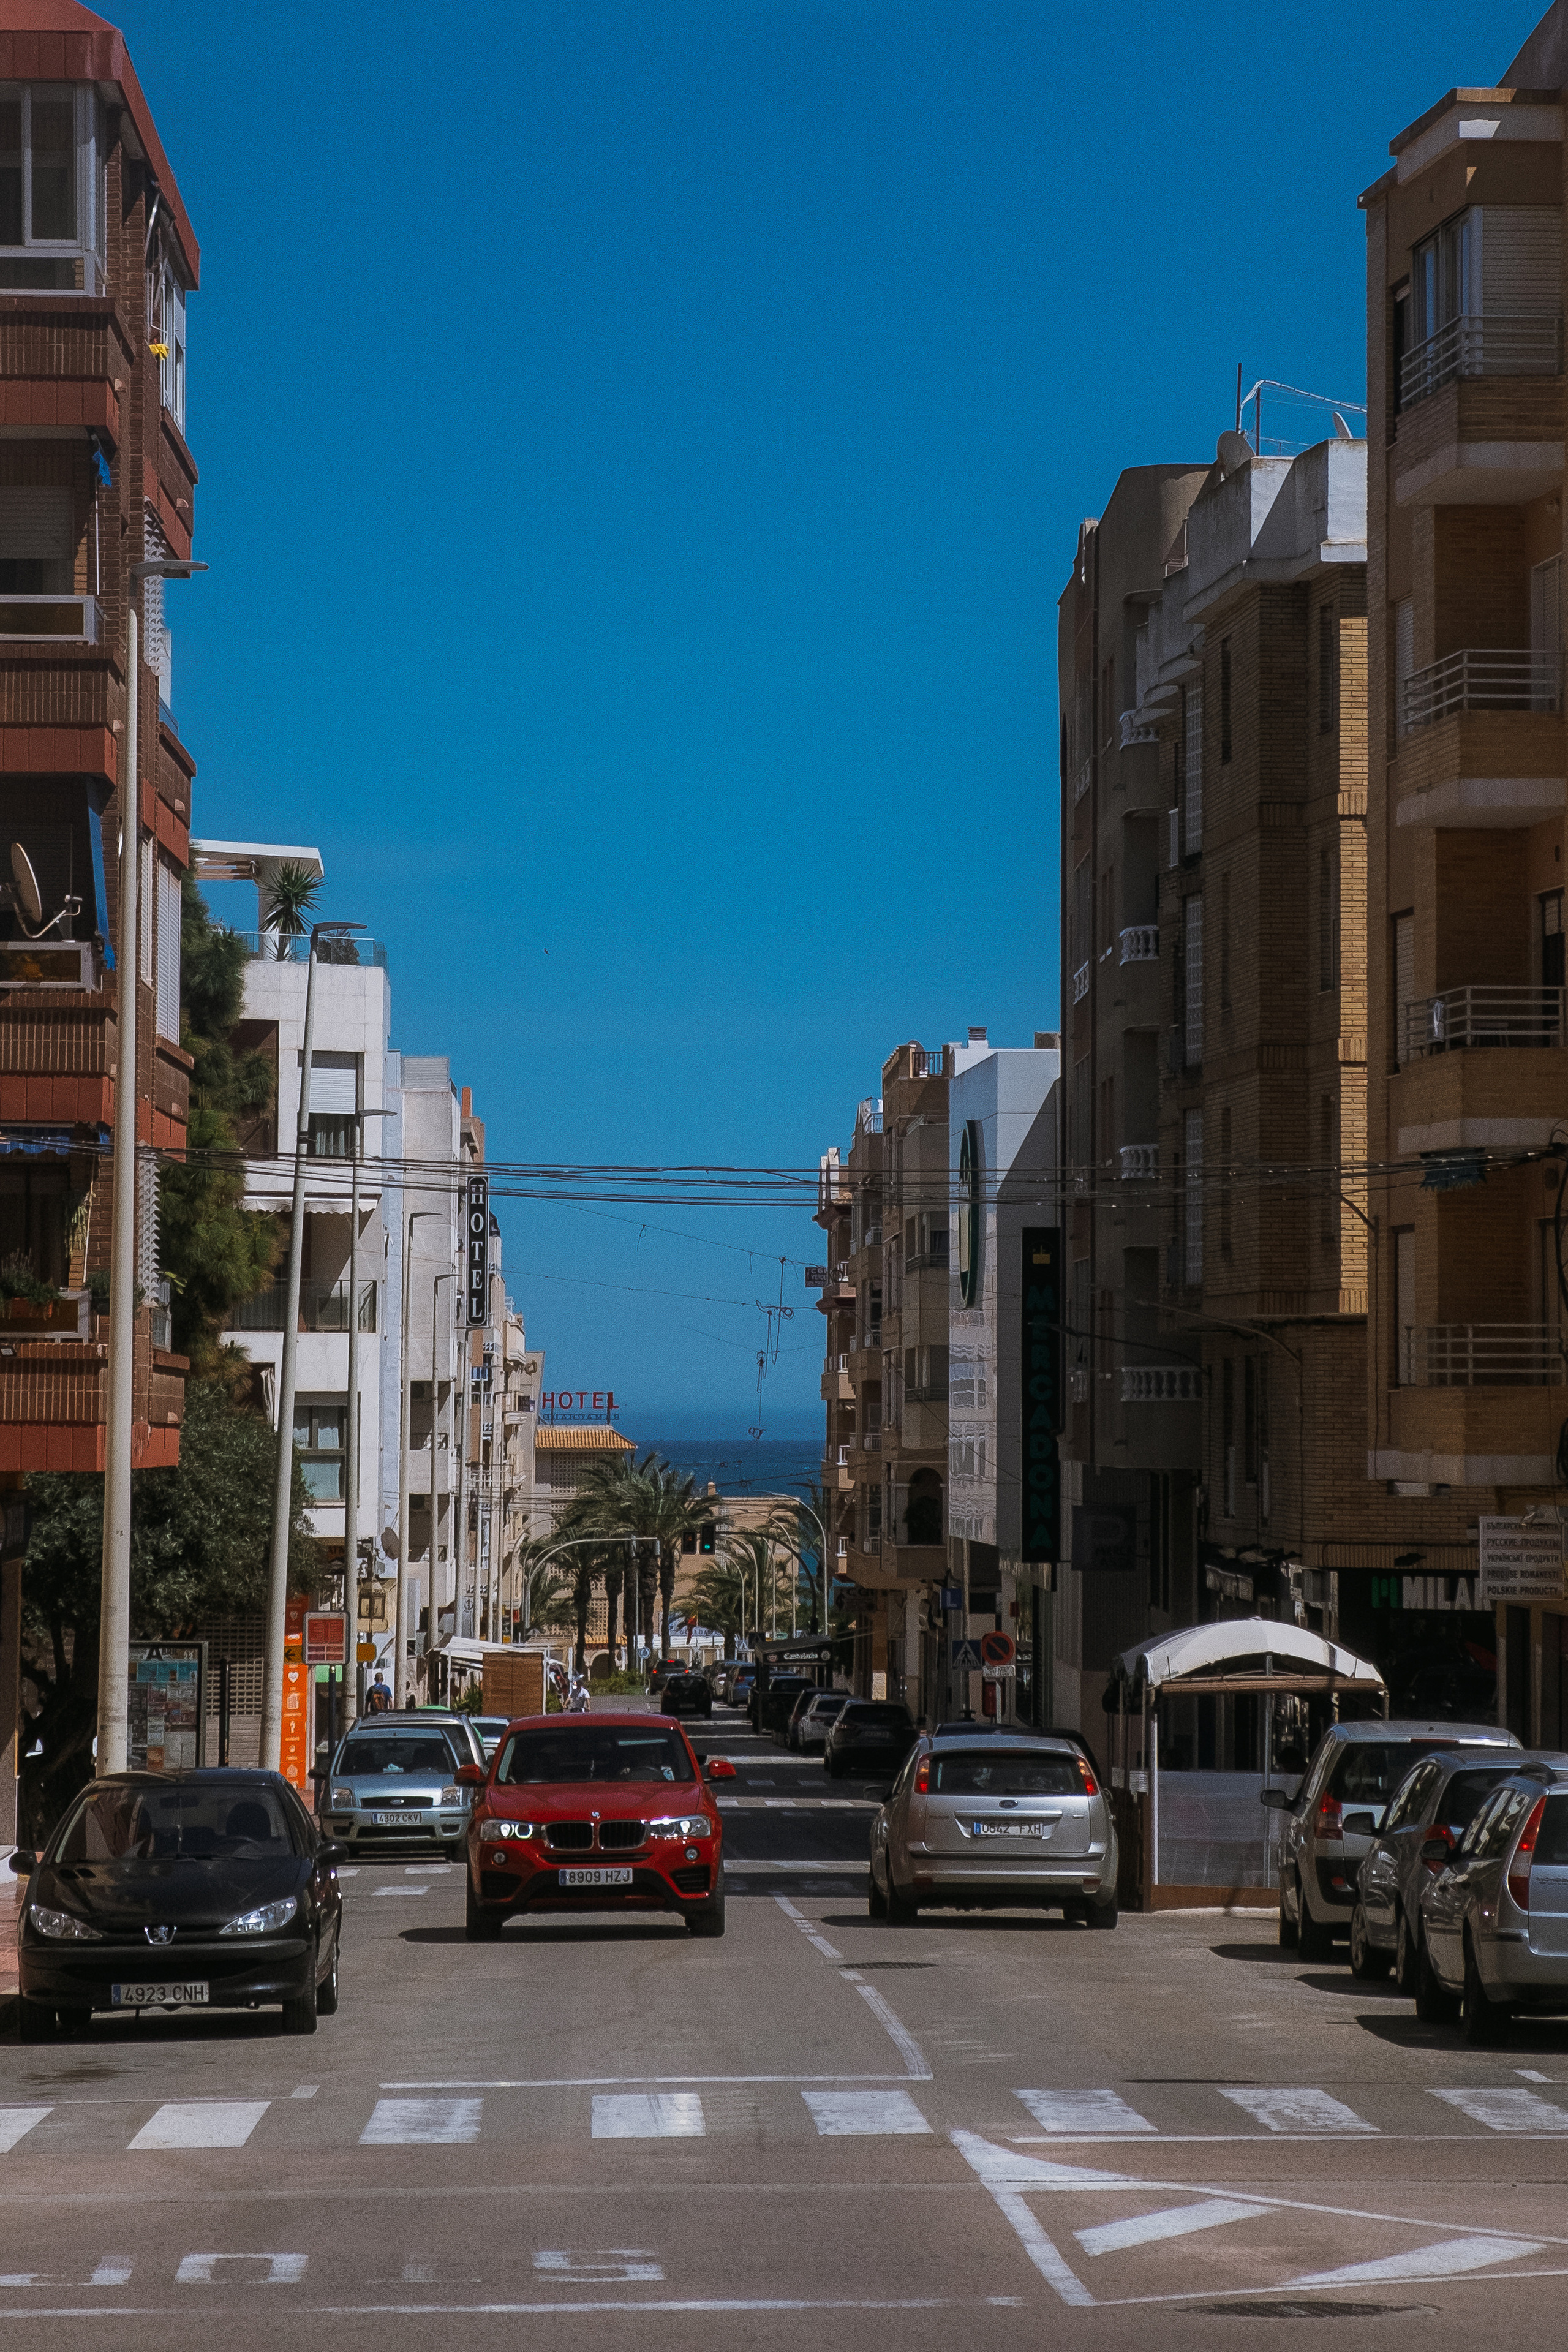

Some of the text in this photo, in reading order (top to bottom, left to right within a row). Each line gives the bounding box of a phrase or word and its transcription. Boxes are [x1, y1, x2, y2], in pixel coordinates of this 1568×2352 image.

[470, 1184, 484, 1318] HOTEL
[542, 1392, 619, 1409] HOTEL
[1026, 1285, 1056, 1549] MERCADONA
[1521, 1538, 1558, 1548] ПРОДУКТЫ
[1521, 1570, 1558, 1578] ROMANESTI
[946, 1591, 957, 1607] L
[379, 1814, 400, 1823] 4302
[1020, 1823, 1041, 1834] FXH
[568, 1871, 630, 1883] 8909 HZJ
[124, 1986, 204, 2002] 4923 CNH
